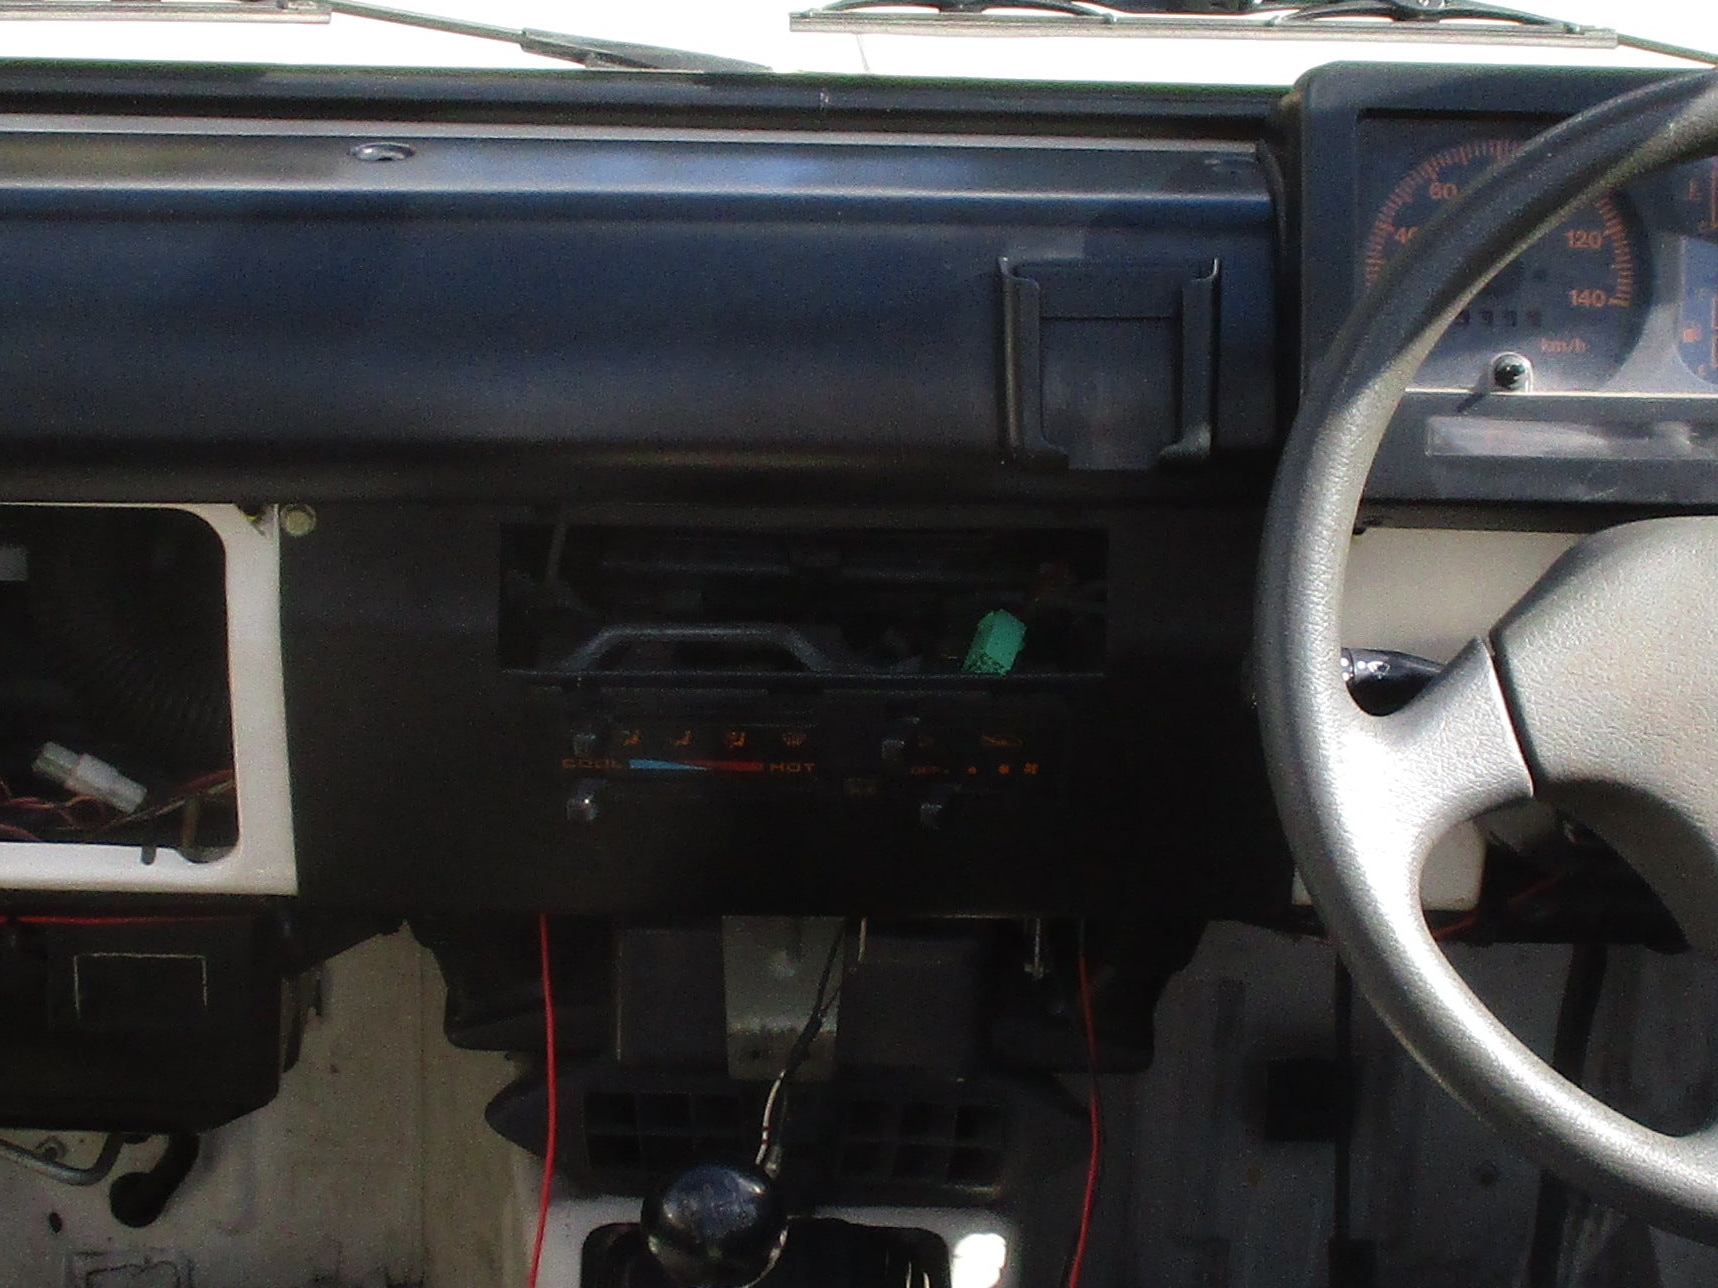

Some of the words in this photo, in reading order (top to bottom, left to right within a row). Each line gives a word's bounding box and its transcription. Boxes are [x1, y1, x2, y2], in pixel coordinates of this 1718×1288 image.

[1429, 182, 1459, 200] 60
[1567, 230, 1603, 249] 120
[1569, 289, 1606, 308] 140
[768, 762, 816, 773] HOT
